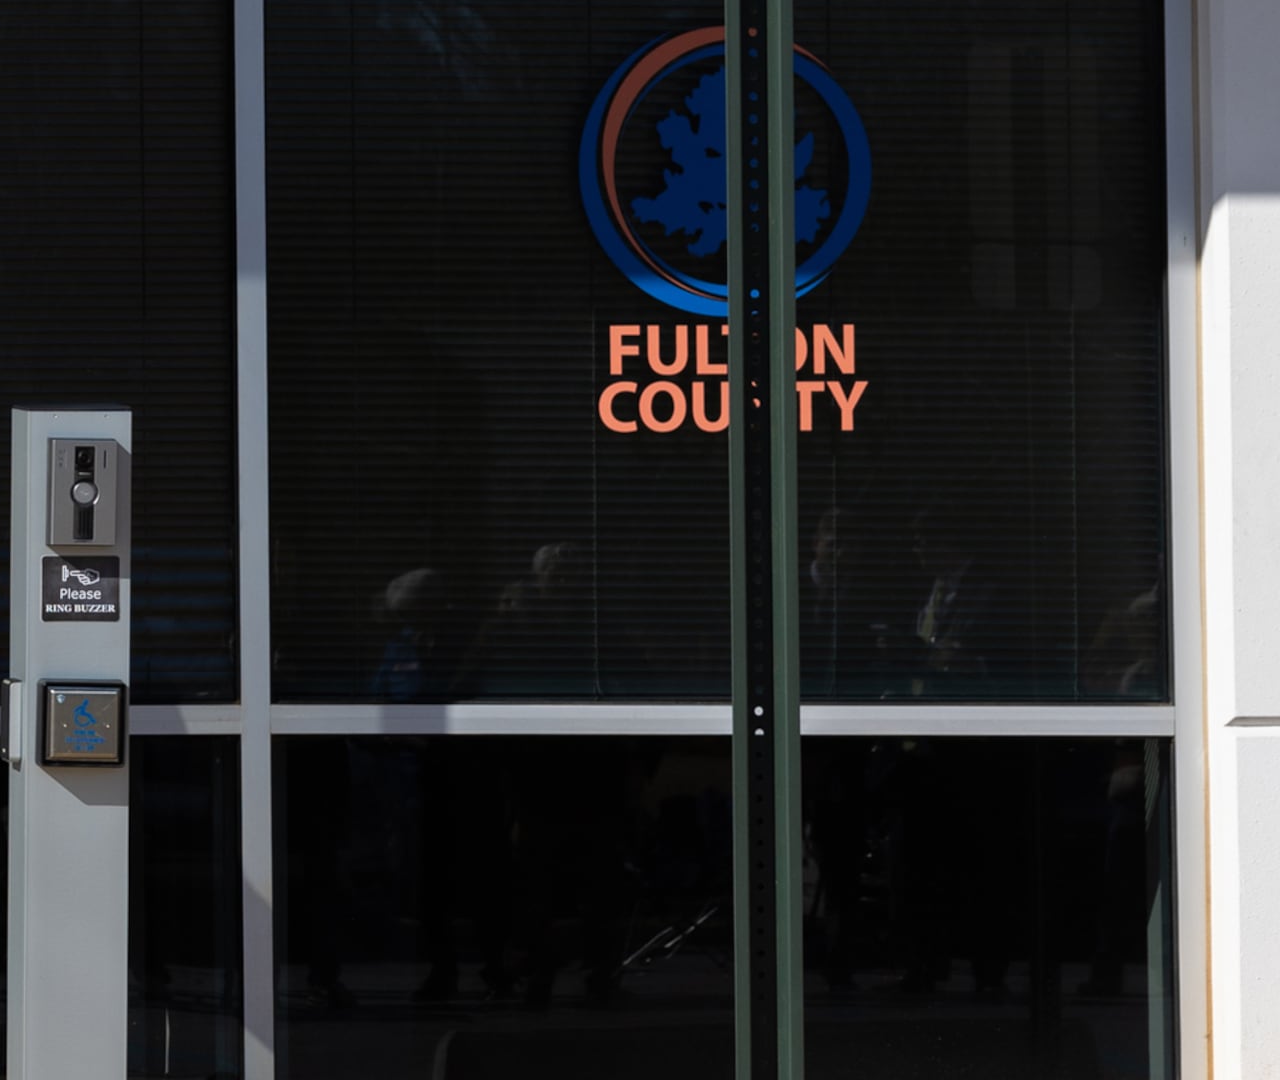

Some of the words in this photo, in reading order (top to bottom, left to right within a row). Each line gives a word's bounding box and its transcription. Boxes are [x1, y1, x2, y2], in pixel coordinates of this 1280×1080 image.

[608, 324, 856, 376] FULN
[598, 380, 869, 433] COUTY
[45, 604, 73, 613] RING
[74, 604, 116, 613] BUZZER
[59, 587, 102, 600] Please
